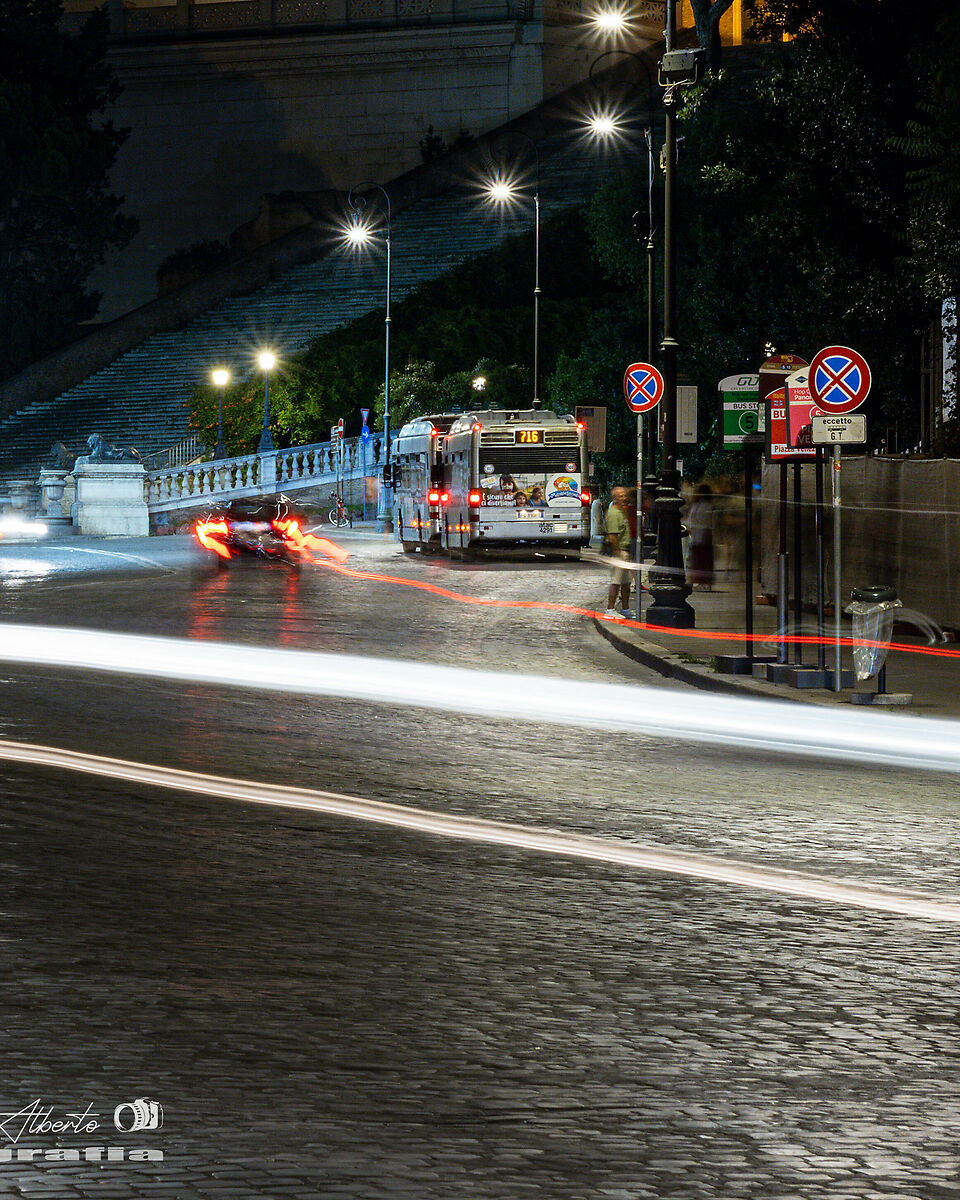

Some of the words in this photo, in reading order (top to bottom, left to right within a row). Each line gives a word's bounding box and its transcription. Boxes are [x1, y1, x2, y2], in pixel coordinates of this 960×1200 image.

[773, 410, 786, 419] BU
[745, 416, 754, 430] 5
[822, 417, 853, 425] eccetto
[520, 430, 539, 443] 716
[797, 434, 811, 444] VE
